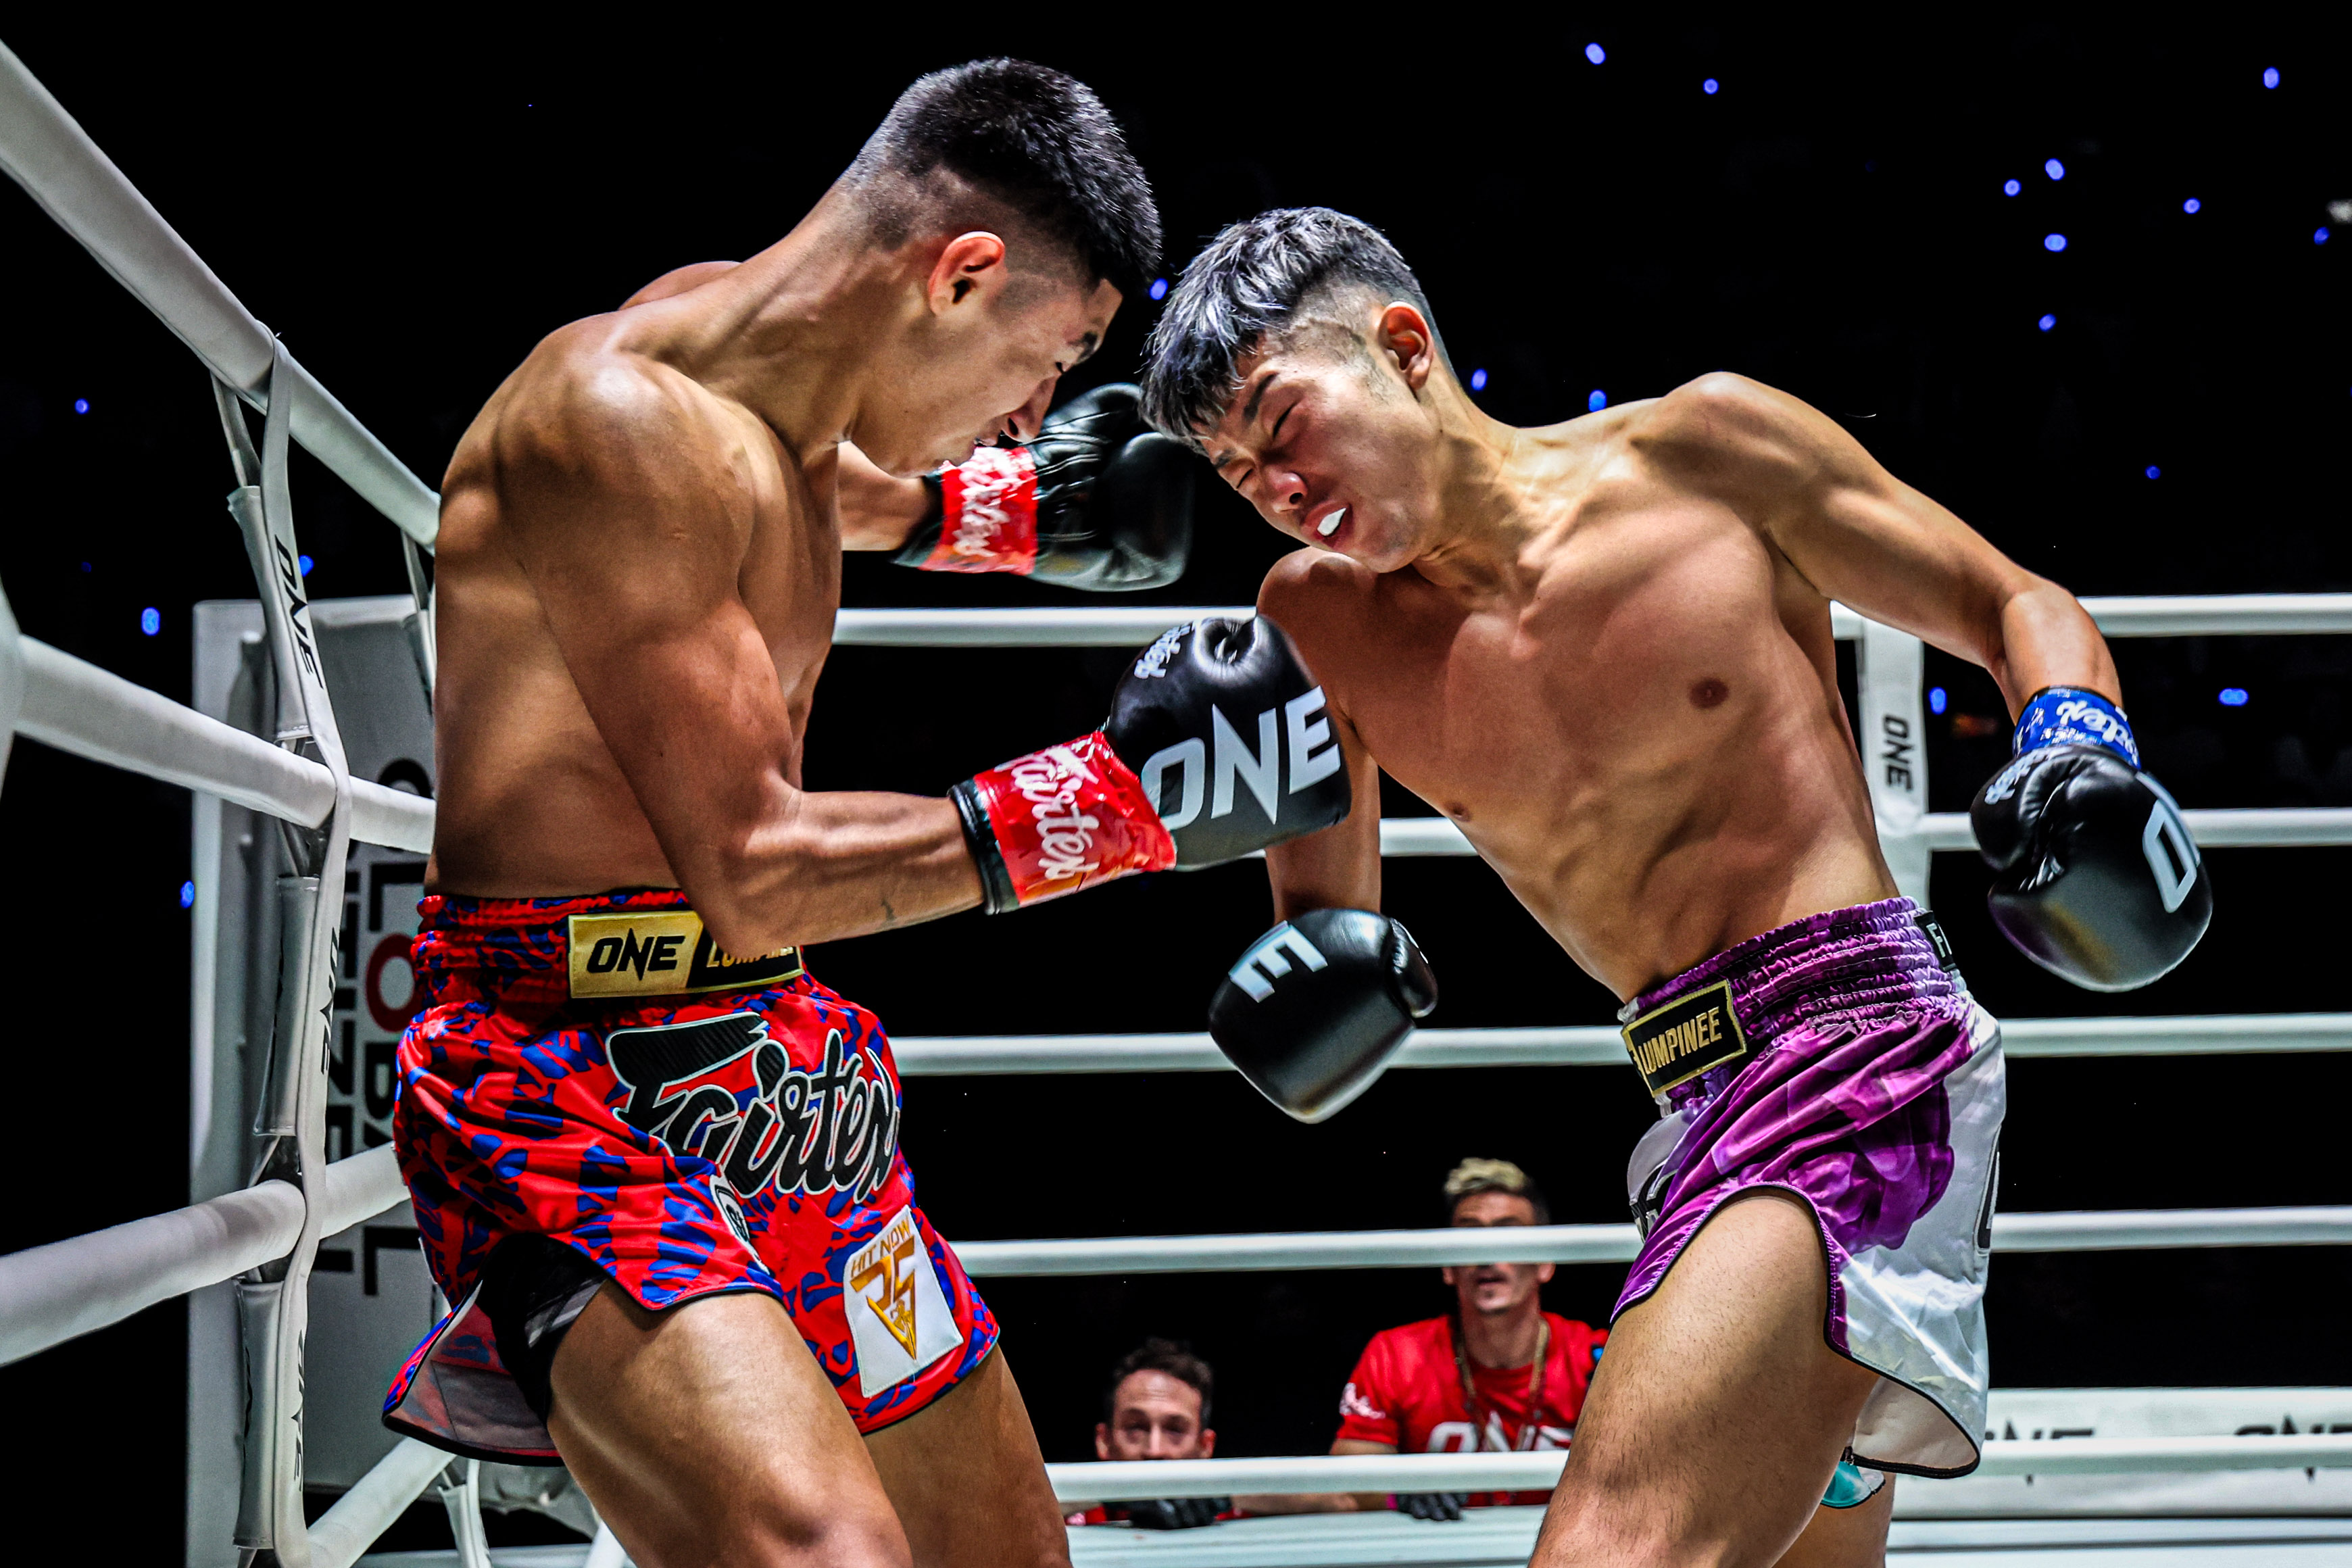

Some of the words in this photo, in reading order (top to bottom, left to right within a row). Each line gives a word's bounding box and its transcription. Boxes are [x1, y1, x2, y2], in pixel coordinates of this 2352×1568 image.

[1141, 685, 1341, 825] ONE
[1882, 713, 1915, 791] ONE
[586, 927, 685, 981] ONE
[364, 758, 434, 1296] LOBL
[1638, 1006, 1722, 1075] LUMPINEE
[852, 1244, 876, 1277] HIT
[880, 1216, 910, 1260] NOW
